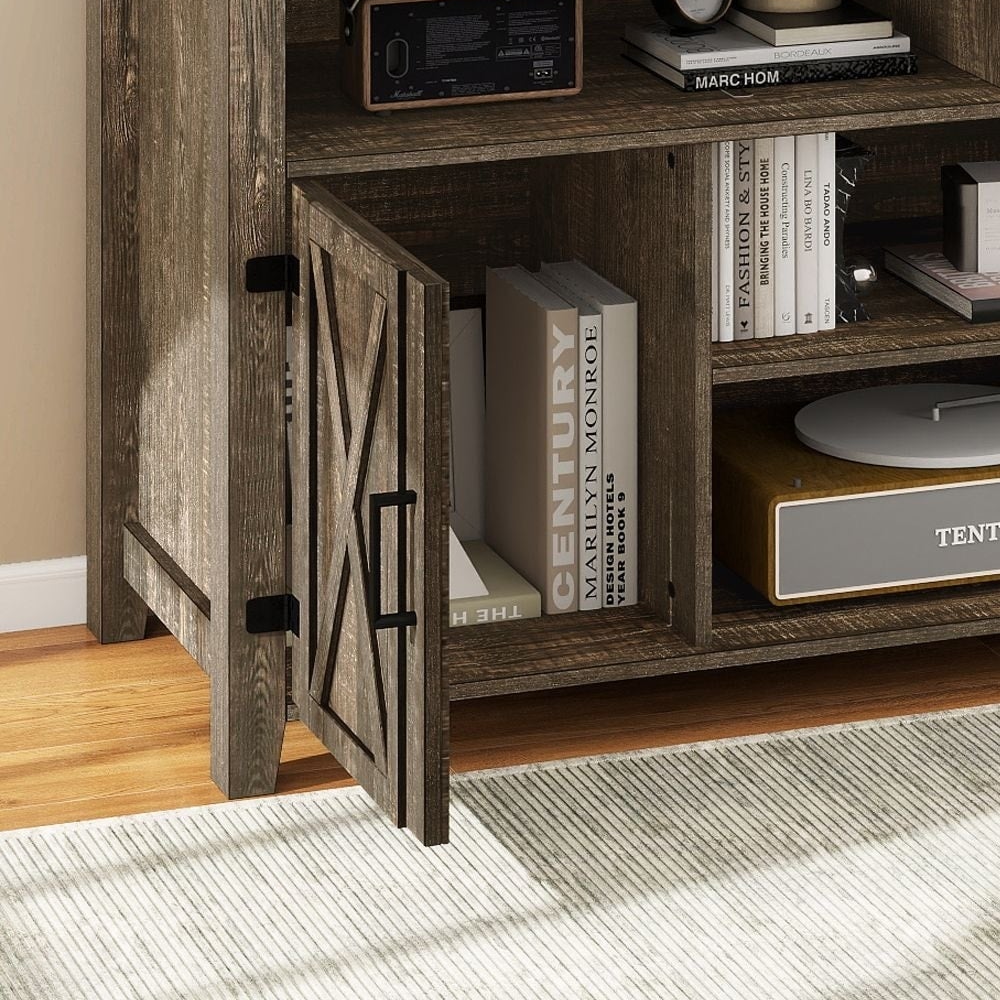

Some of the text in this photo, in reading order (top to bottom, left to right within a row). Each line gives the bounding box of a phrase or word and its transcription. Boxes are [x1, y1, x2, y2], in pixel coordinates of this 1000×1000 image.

[695, 70, 780, 90] MARC HOM
[774, 48, 832, 59] BORDEAUX
[738, 188, 750, 204] &
[759, 158, 770, 286] BRINGING THE HOUSE HOME
[780, 162, 790, 219] Constructing
[803, 169, 813, 252] LINA BO BARDI
[823, 182, 831, 247] TADAO ANDO
[738, 212, 750, 308] FASHION
[552, 323, 575, 611] CENTURY
[585, 324, 598, 600] MARILYN MONROE
[606, 472, 615, 606] DESIGN HOTELS
[617, 491, 626, 605] YEAR BOOK 9
[452, 605, 523, 626] THE H
